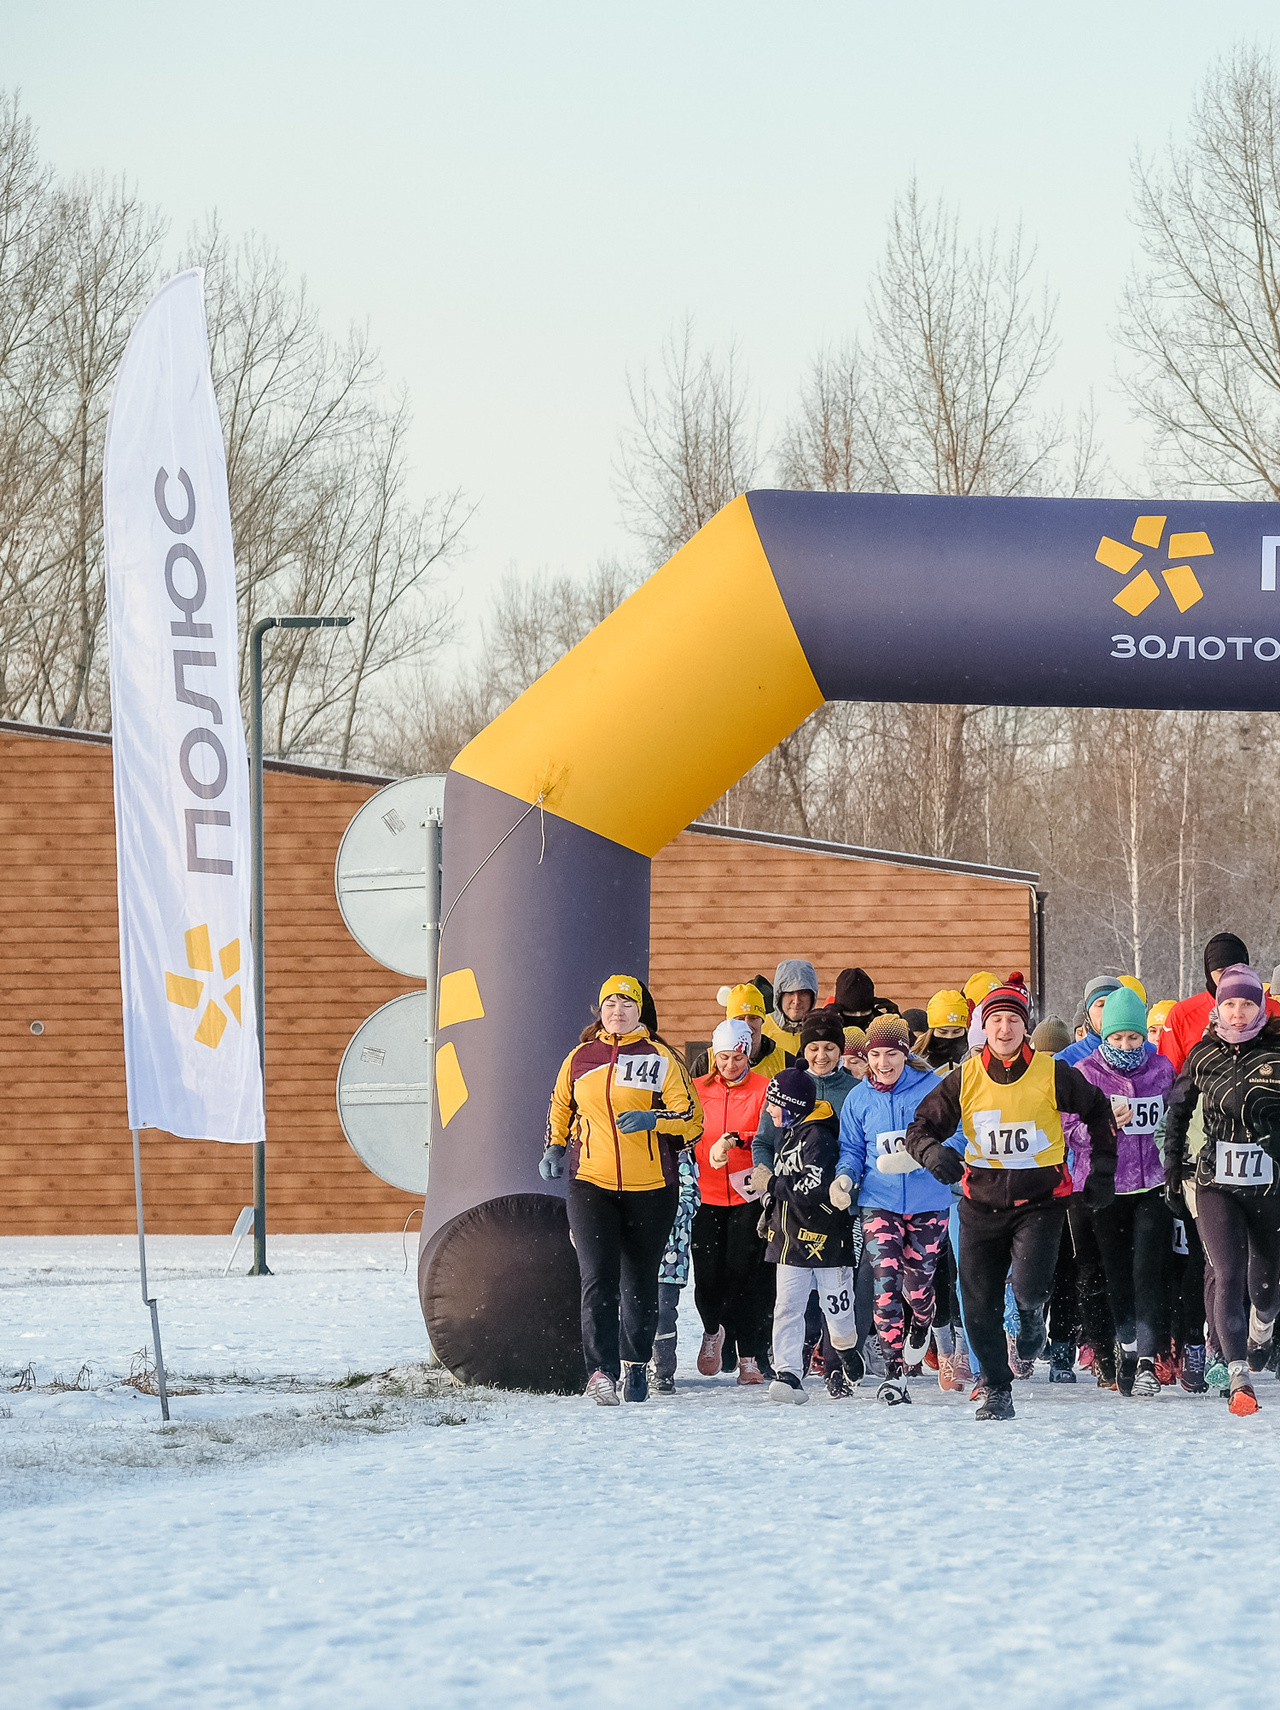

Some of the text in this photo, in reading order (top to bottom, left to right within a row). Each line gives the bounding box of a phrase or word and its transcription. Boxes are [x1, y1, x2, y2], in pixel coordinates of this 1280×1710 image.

[154, 466, 234, 876] ПОЛЮС
[623, 1060, 661, 1085] 144
[776, 1091, 807, 1107] LEAGUE
[988, 1128, 1029, 1155] 176
[1224, 1150, 1264, 1178] 177
[827, 1289, 850, 1315] 38
